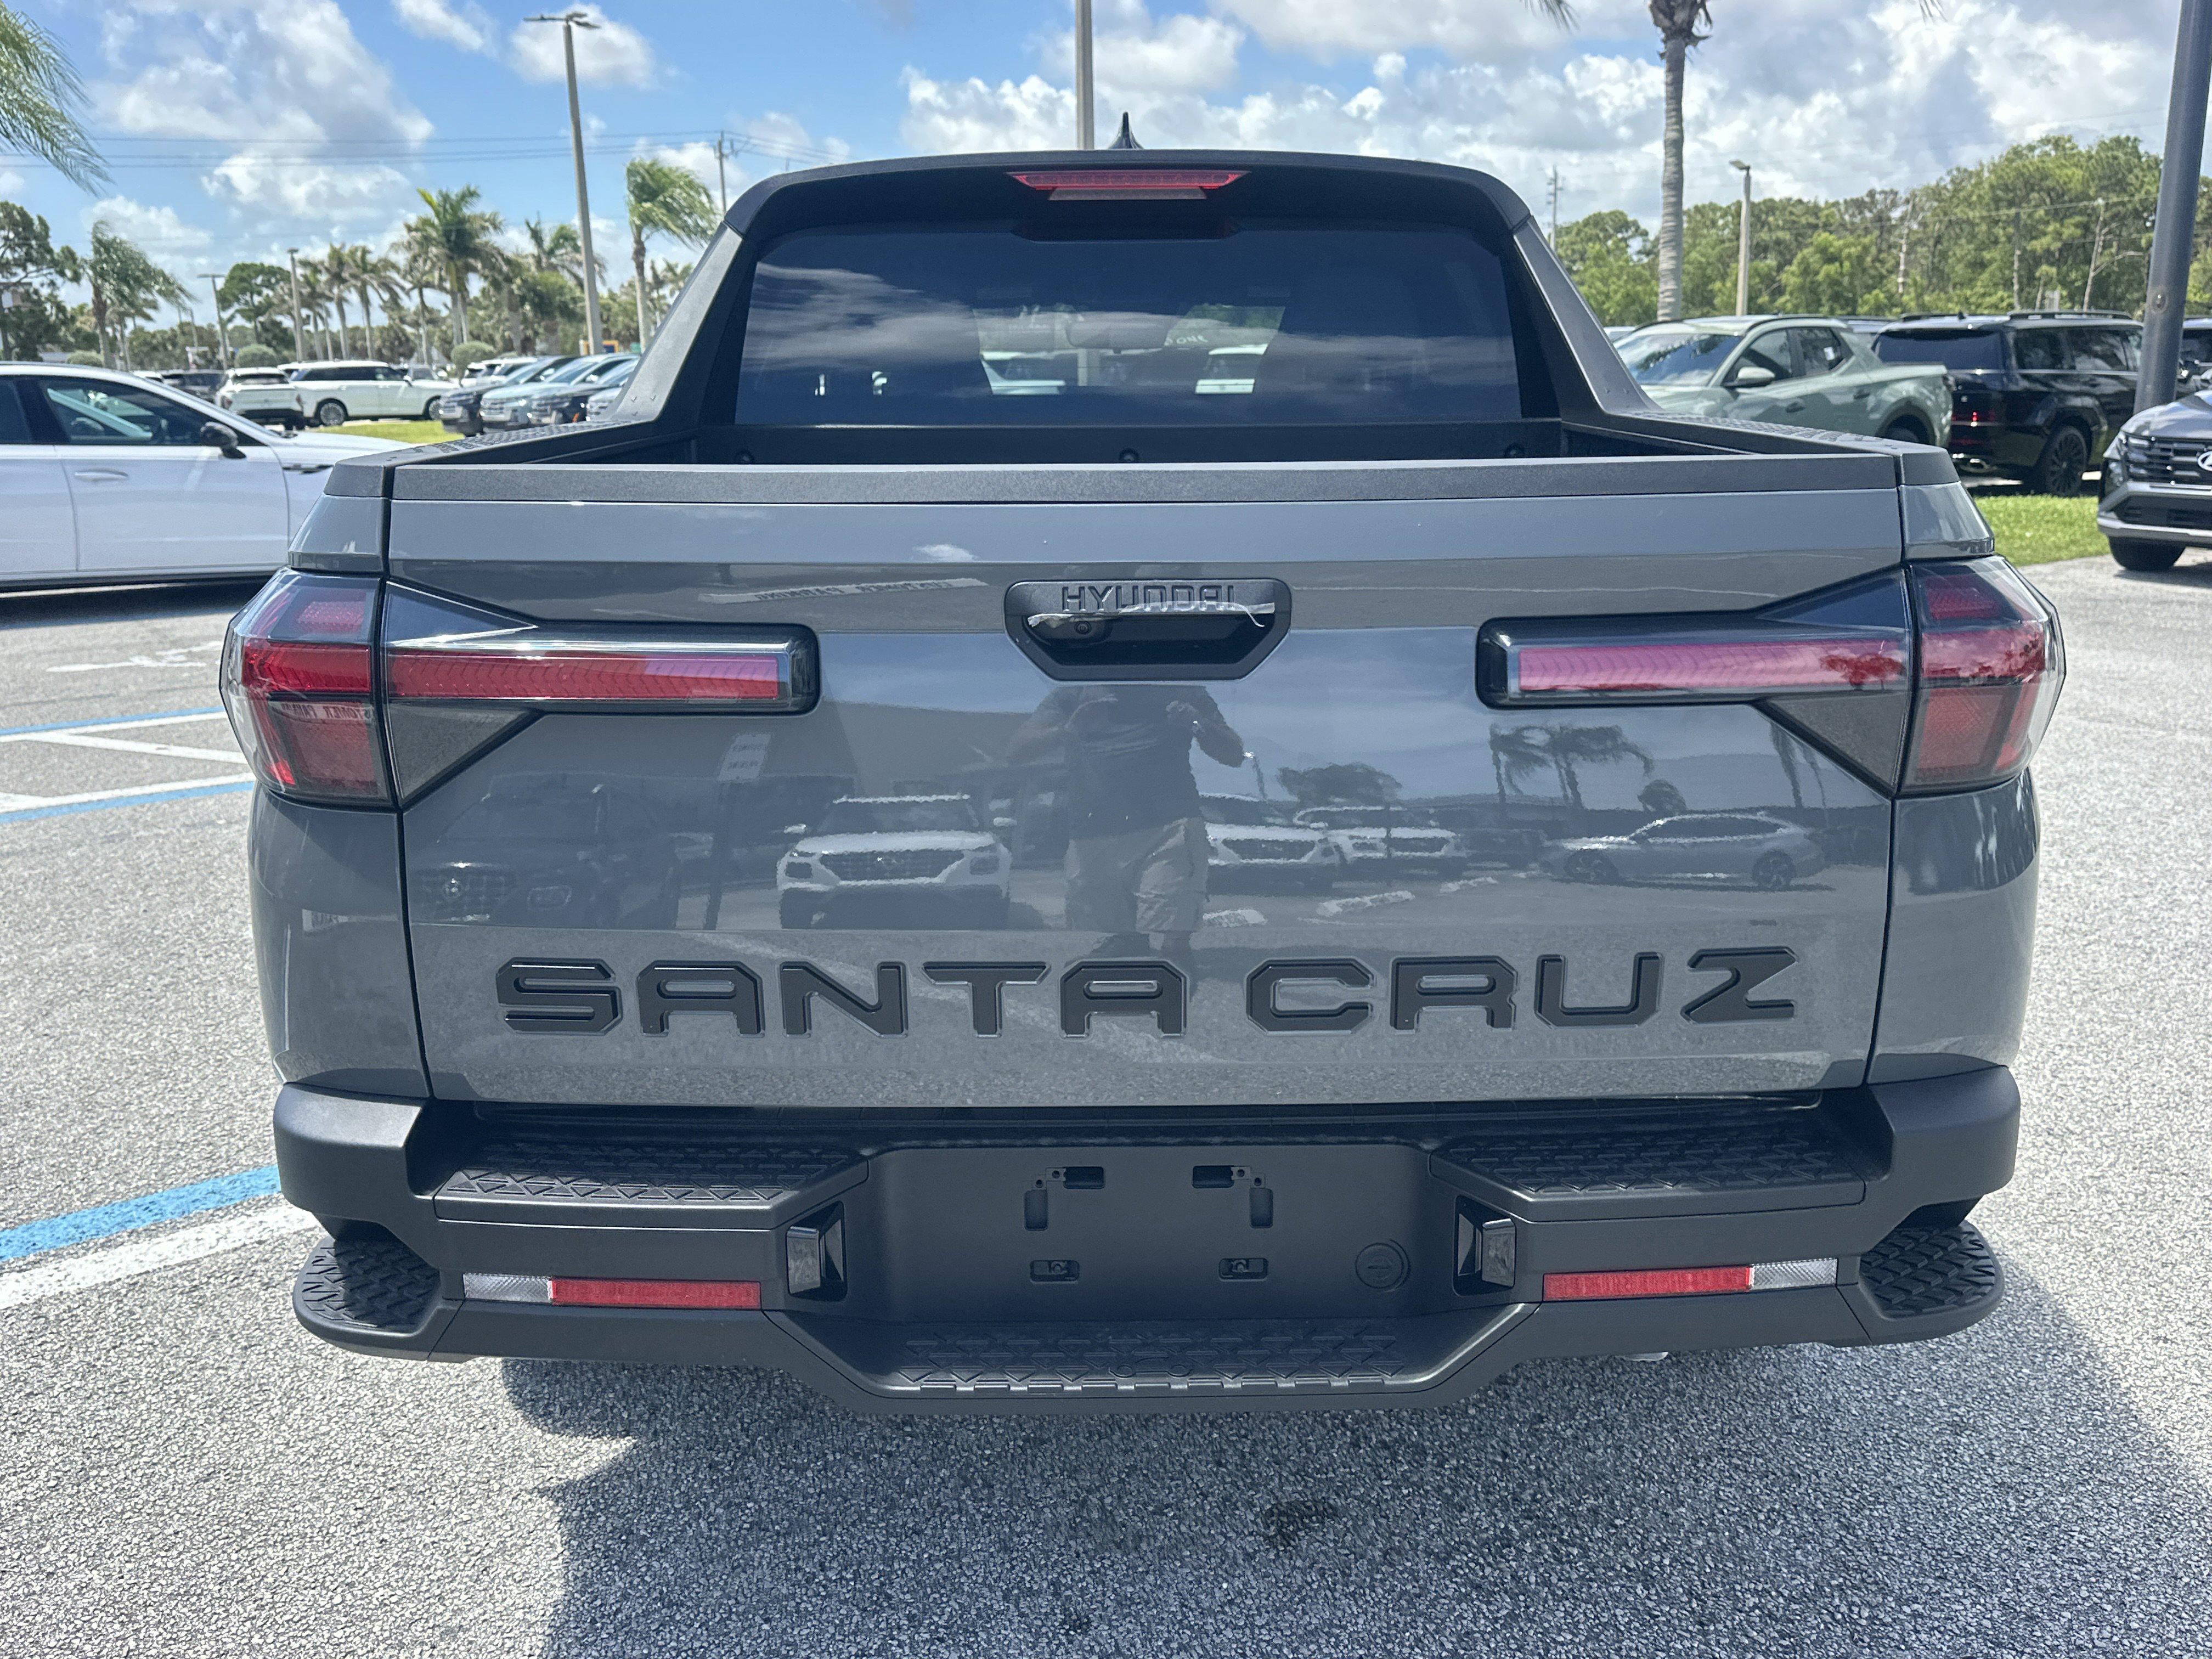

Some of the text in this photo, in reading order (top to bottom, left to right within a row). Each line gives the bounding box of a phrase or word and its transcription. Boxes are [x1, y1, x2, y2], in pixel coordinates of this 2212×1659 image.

[1061, 585, 1235, 613] HYUNDAI
[495, 946, 1799, 1039] SANTA CRUZ
